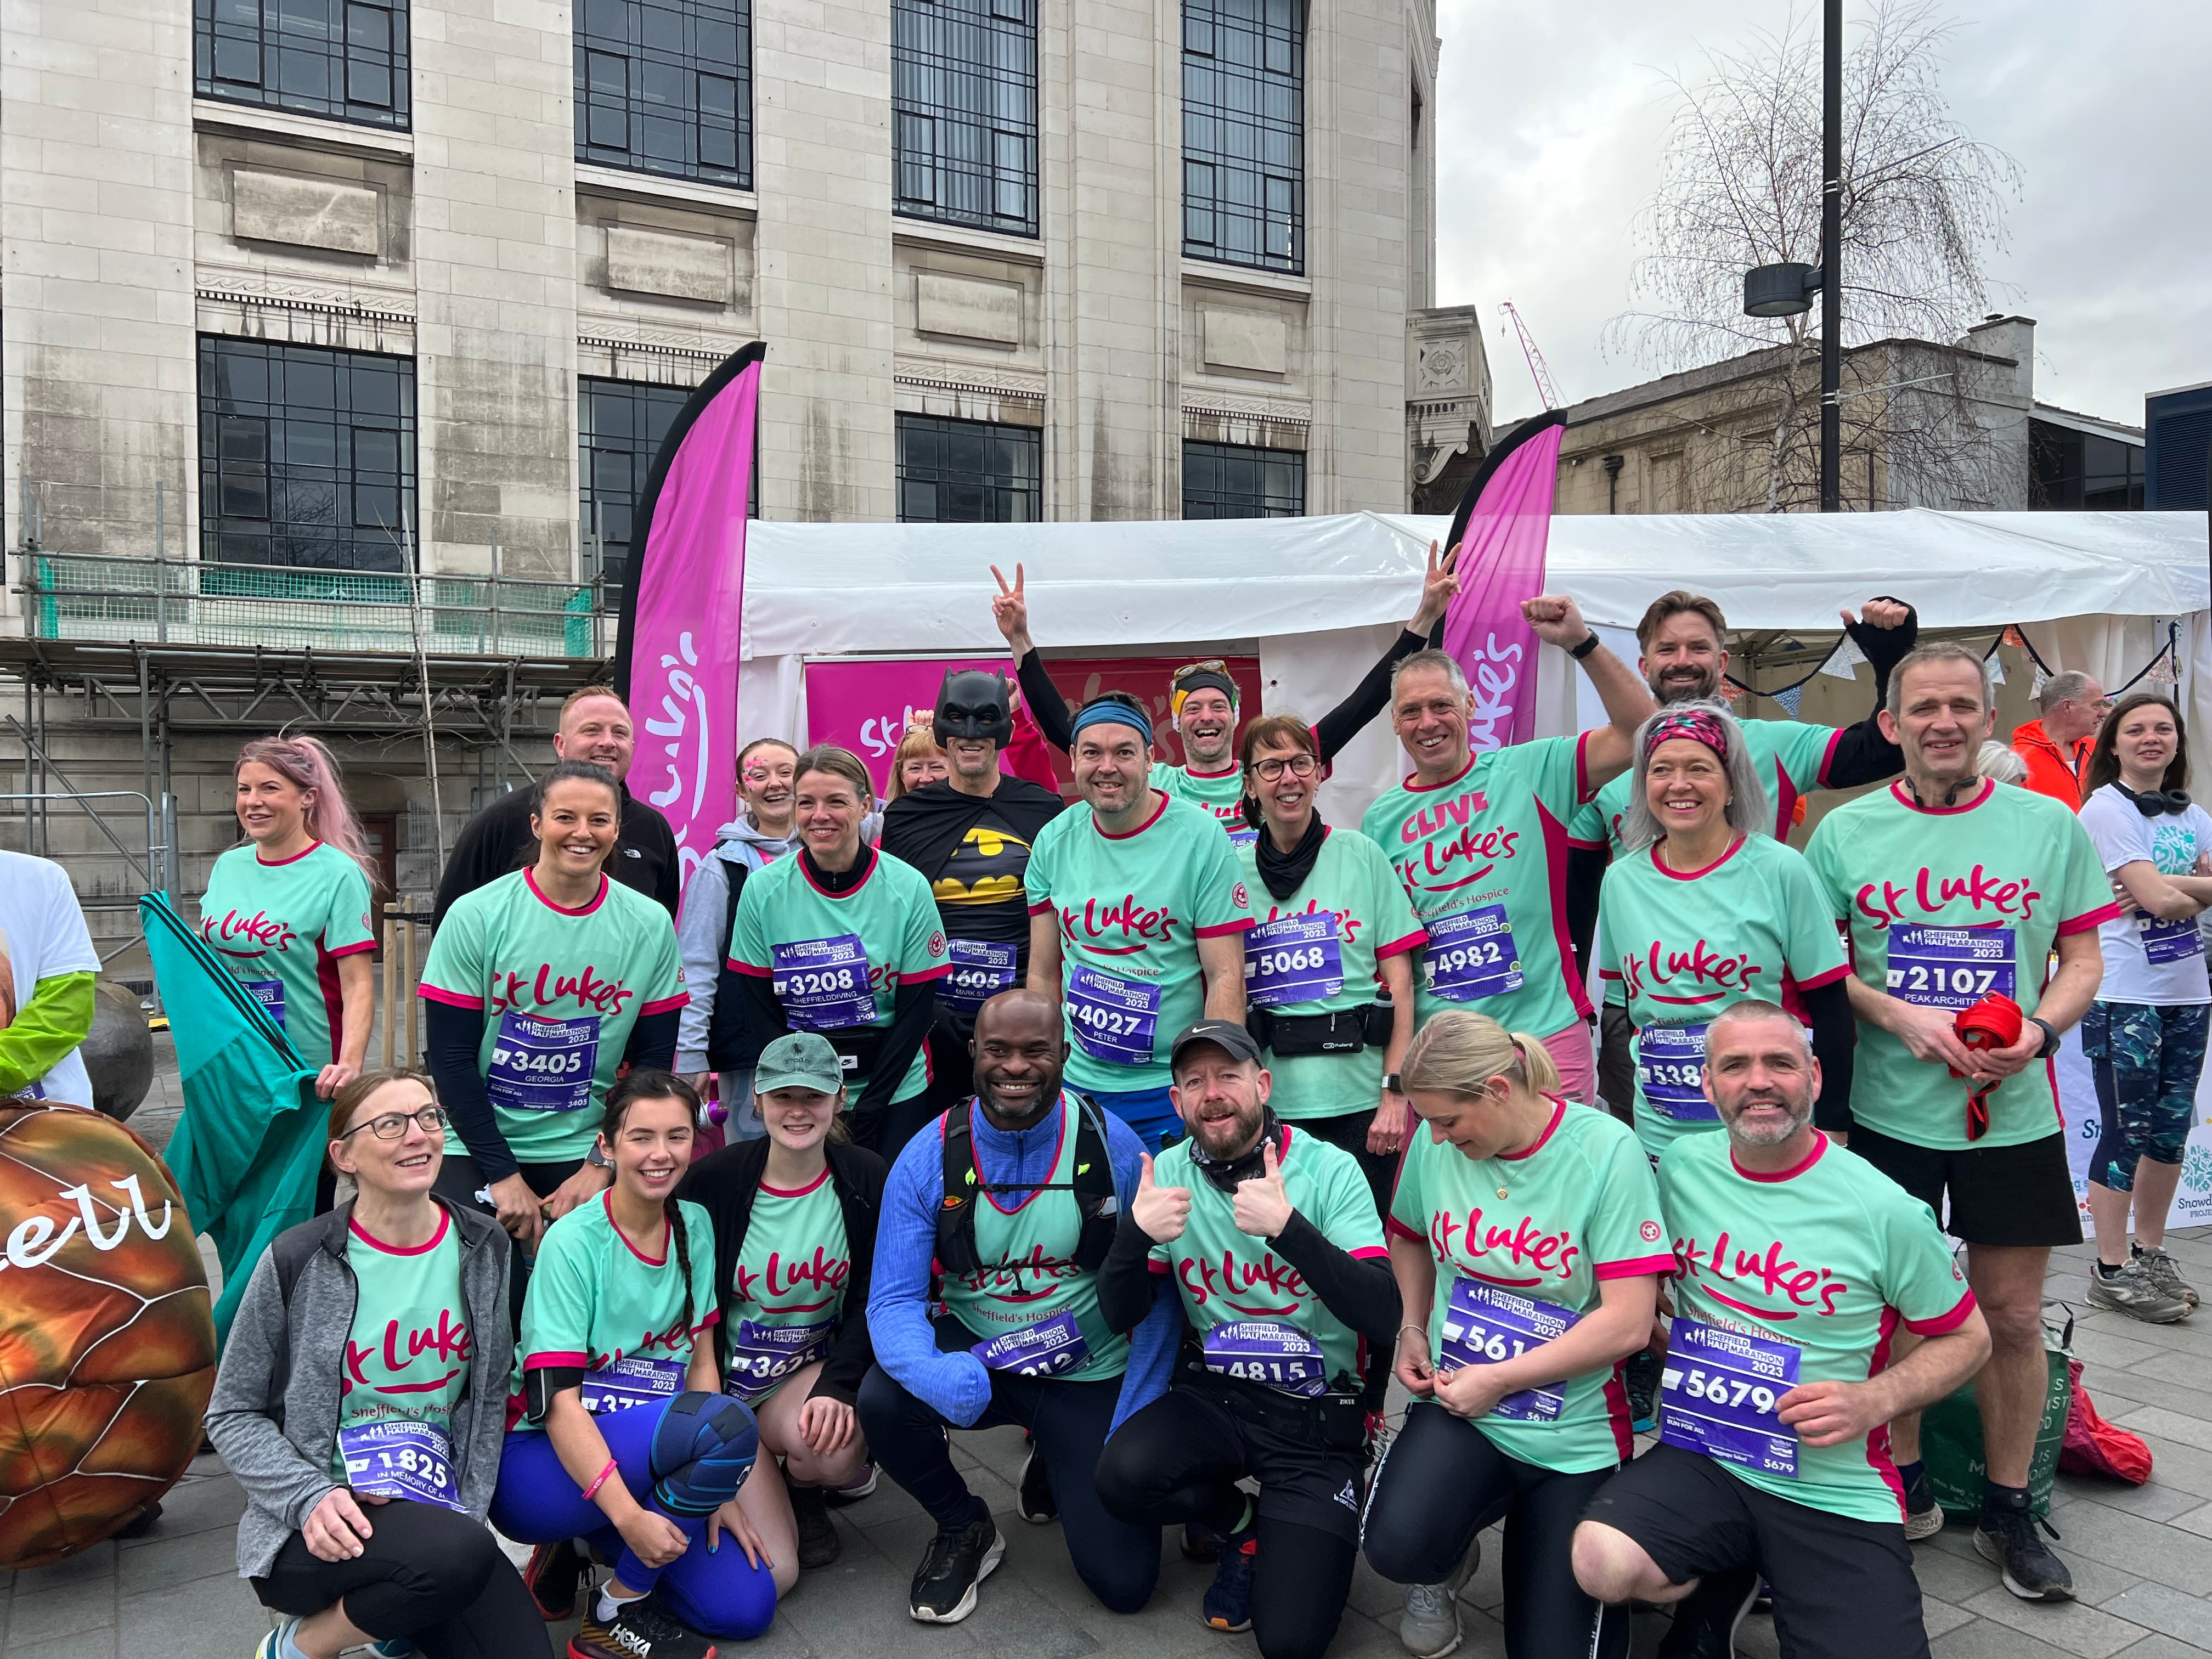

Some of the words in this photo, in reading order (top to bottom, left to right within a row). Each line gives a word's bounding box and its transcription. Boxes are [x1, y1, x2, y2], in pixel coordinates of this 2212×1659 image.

[1470, 632, 1523, 752] uke's
[860, 715, 899, 757] St
[1401, 791, 1488, 844] CLIVE
[1424, 826, 1519, 876] Luke's
[1417, 899, 1464, 918] Sheffield's
[1467, 888, 1509, 905] Hospice
[1856, 881, 1909, 930] St
[1916, 864, 2041, 920] Luke's
[1085, 894, 1178, 943] Luke's
[1268, 921, 1297, 929] SHEFFIELD
[1436, 917, 1468, 929] SHEFFIELD
[1438, 927, 1454, 936] HALF
[1455, 917, 1496, 930] MARATHON
[221, 909, 297, 952] Luke's
[1285, 923, 1324, 933] MARATHON
[1304, 929, 1327, 939] 2023
[1475, 923, 1499, 935] 2023
[796, 943, 826, 951] SHEFFIELD
[814, 945, 853, 956] MARATHON
[957, 941, 986, 950] SHEFFIELD
[1973, 949, 2004, 958] 2023
[832, 951, 855, 961] 2023
[1261, 947, 1324, 976] 5068
[1439, 942, 1502, 973] 4982
[1649, 939, 1762, 993] Luke's
[790, 969, 854, 996] 3208
[868, 962, 899, 993] e's
[946, 969, 1000, 989] 1605
[1095, 976, 1124, 988] SHEFFIELD
[1909, 966, 1997, 994] 2107
[492, 972, 529, 1017] St
[534, 963, 633, 1016] Luke's
[793, 991, 857, 1004] SHEFFIELDDIVING
[1094, 982, 1109, 991] HALF
[1109, 986, 1149, 1000] MARATHON
[1125, 997, 1149, 1009] 2023
[1905, 994, 1931, 1003] PEAK
[1933, 996, 1977, 1006] ARCHITE
[855, 1012, 876, 1022] 3208
[1079, 1005, 1141, 1036] 4027
[533, 1023, 566, 1032] SHEFFIELD
[550, 1027, 590, 1037] MARATHON
[568, 1034, 590, 1044] 2023
[1093, 1031, 1118, 1043] PETER
[1692, 1045, 1706, 1053] 20
[511, 1051, 582, 1074] 3405
[1653, 1065, 1703, 1087] 538
[567, 1099, 588, 1108] 3405
[2178, 1194, 2212, 1209] Snowd
[0, 1173, 172, 1273] ell
[1431, 1210, 1462, 1263] St
[1465, 1207, 1579, 1279] Luke's
[766, 1246, 849, 1297] Luke
[1178, 1257, 1220, 1305] St
[1223, 1250, 1311, 1301] Luke
[1673, 1237, 1706, 1280] St
[1708, 1232, 1847, 1316] Luke's
[1492, 1291, 1533, 1310] SHEFFIELD
[972, 1302, 1023, 1323] Sheffield's
[1026, 1303, 1071, 1323] Hospice
[1491, 1299, 1513, 1312] HALF
[1513, 1307, 1565, 1329] MARATHON
[1533, 1322, 1564, 1338] 2023
[1688, 1304, 1747, 1335] Sheffield's
[1751, 1324, 1812, 1346] Hosp
[383, 1308, 472, 1372] Luke
[1001, 1330, 1034, 1345] SHEFFIELD
[1004, 1341, 1021, 1352] HALF
[1021, 1326, 1065, 1346] MARATHON
[1043, 1333, 1069, 1349] 2023
[1240, 1331, 1260, 1340] HALF
[1261, 1333, 1306, 1342] MARATHO
[1465, 1325, 1525, 1361] 561
[1708, 1331, 1749, 1347] SHEFFIELD
[1283, 1342, 1311, 1352] 2023
[1707, 1339, 1729, 1352] HALF
[1730, 1346, 1783, 1365] MARATHON
[617, 1360, 652, 1369] SHEFFIELD
[752, 1348, 816, 1378] 3625
[1228, 1362, 1307, 1382] 4815
[1751, 1361, 1784, 1378] 2023
[617, 1366, 634, 1374] HALF
[635, 1370, 676, 1381] MARATHON
[652, 1380, 676, 1391] 2023
[1686, 1369, 1775, 1415] 5679
[351, 1403, 420, 1419] Sheffield's
[602, 1395, 650, 1413] 37
[386, 1427, 409, 1436] HALF
[1667, 1418, 1680, 1427] RUN
[1681, 1422, 1693, 1431] FOR
[1694, 1426, 1705, 1435] ALL
[377, 1448, 447, 1488] 1825
[1763, 1457, 1795, 1473] 5679
[391, 1471, 426, 1488] MEMORY
[428, 1485, 438, 1495] OF
[1950, 1484, 1965, 1497] bag
[608, 1622, 652, 1659] HOKA
